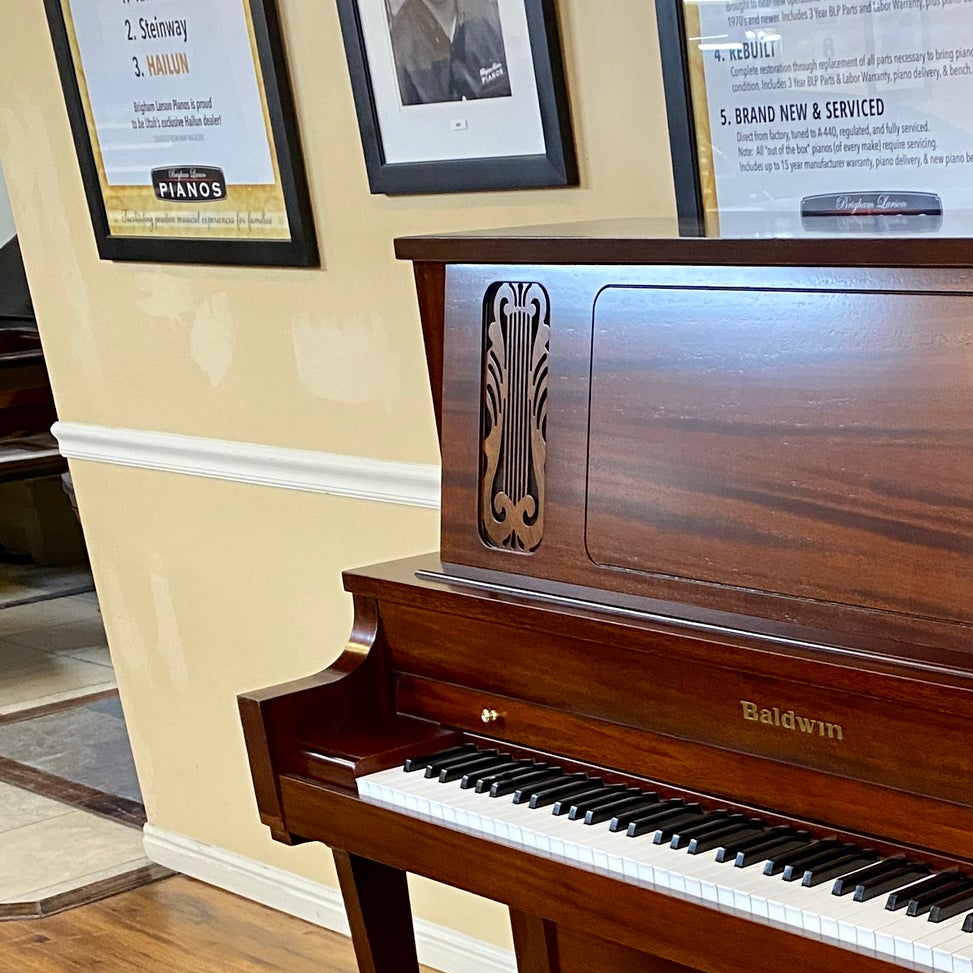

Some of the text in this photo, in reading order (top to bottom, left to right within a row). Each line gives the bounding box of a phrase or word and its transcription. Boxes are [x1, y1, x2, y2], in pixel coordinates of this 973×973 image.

[749, 15, 759, 25] and
[782, 10, 808, 21] Includes
[809, 8, 814, 19] 3
[814, 7, 827, 18] Year
[829, 5, 841, 17] BLP
[842, 3, 857, 15] Parts
[860, 2, 871, 14] and
[874, 0, 891, 12] Labor
[125, 16, 187, 42] 2. Steinway
[714, 41, 776, 62] 4. REBUILT
[730, 65, 758, 78] Complete
[760, 62, 791, 74] restoration
[792, 60, 817, 76] through
[819, 56, 858, 71] replacement
[859, 55, 866, 66] of
[867, 54, 875, 66] all
[877, 54, 893, 68] parts
[894, 52, 926, 64] necessary
[927, 50, 934, 61] to
[935, 48, 954, 62] bring
[132, 52, 189, 77] 3. HAILUN
[761, 79, 787, 90] Includes
[788, 78, 793, 88] 3
[793, 77, 806, 88] Year
[807, 76, 819, 87] BLP
[820, 75, 835, 86] Parts
[836, 74, 842, 84] &
[843, 72, 860, 84] Labor
[862, 71, 892, 84] Warranty,
[893, 69, 912, 83] piano
[913, 66, 942, 81] delivery,
[942, 65, 948, 77] &
[949, 63, 973, 76] bench.
[196, 97, 212, 112] proud
[720, 98, 885, 126] 5. BRAND NEW & SERVICED
[736, 120, 930, 142] Direct from factory, tuned to A-440, regulated, and fully serviced.
[738, 147, 753, 157] Note:
[756, 145, 764, 156] All
[778, 143, 786, 155] of
[786, 143, 795, 155] the
[797, 143, 810, 154] box"
[812, 143, 832, 156] pianos
[833, 141, 842, 154] (of
[843, 143, 860, 154] every
[862, 140, 881, 152] make)
[882, 140, 905, 152] require
[907, 138, 938, 151] servicing.
[739, 161, 763, 172] Includes
[764, 162, 772, 173] up
[773, 161, 780, 170] to
[781, 160, 789, 170] 15
[790, 161, 803, 172] year
[804, 158, 845, 169] manufacturer
[846, 157, 874, 170] warranty,
[875, 156, 893, 169] piano
[895, 154, 922, 168] delivery,
[923, 153, 929, 164] &
[930, 155, 944, 164] new
[945, 153, 964, 166] piano
[159, 182, 222, 198] PIANOS
[835, 194, 907, 215] Brigham Larson
[740, 700, 843, 741] Baldwin
